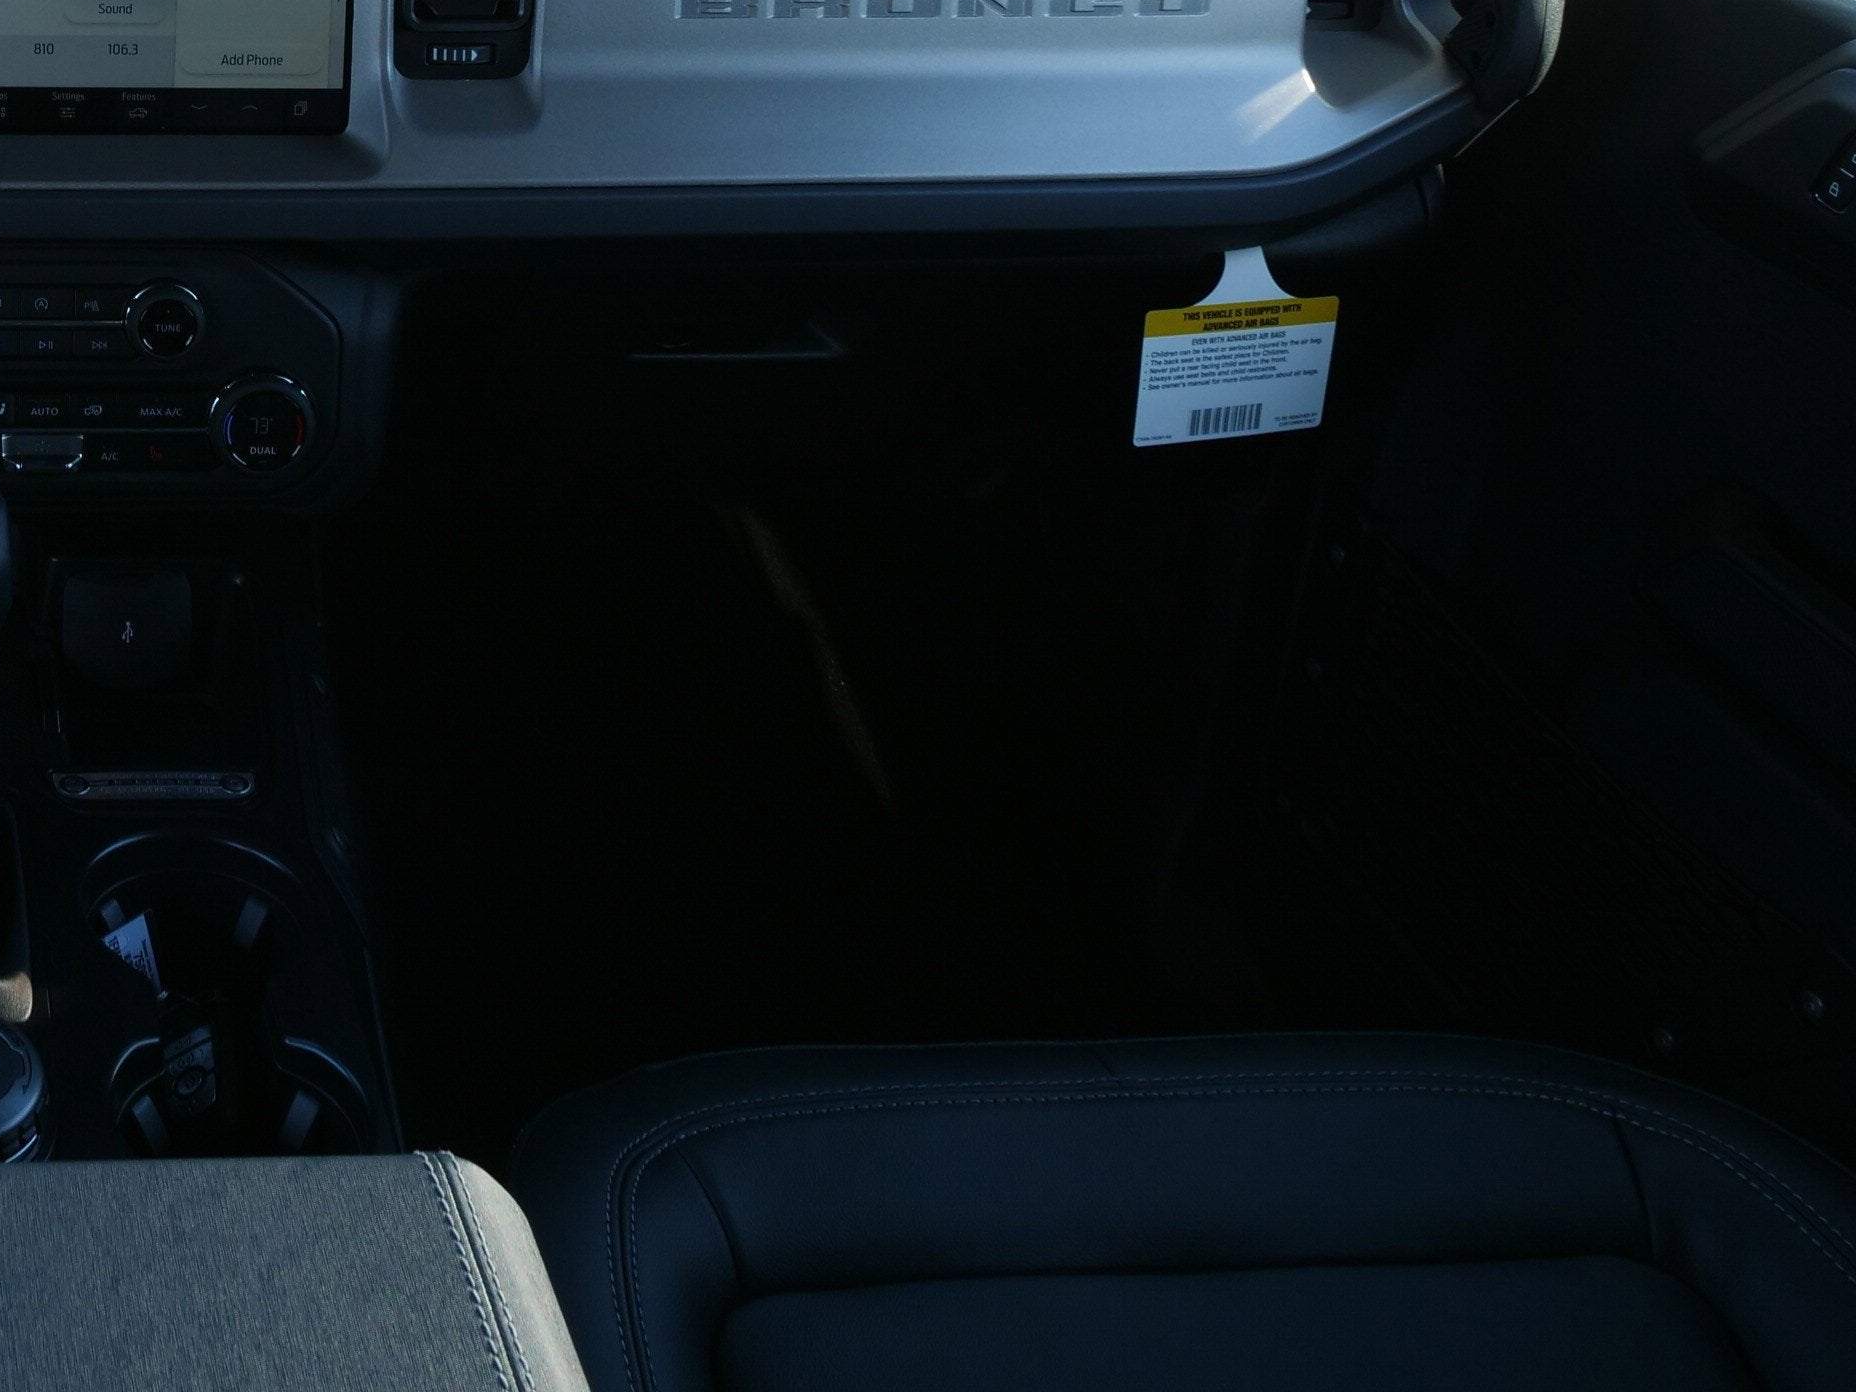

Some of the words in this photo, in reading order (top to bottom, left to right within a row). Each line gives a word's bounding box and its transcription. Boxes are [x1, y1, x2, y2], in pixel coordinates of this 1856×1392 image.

[98, 3, 133, 15] Sound
[34, 43, 54, 55] 810
[107, 43, 139, 56] 106.3
[221, 54, 243, 67] Add
[245, 54, 283, 67] Phone
[52, 92, 85, 102] Settings
[121, 92, 156, 101] Features
[1183, 312, 1200, 321] THIS
[1202, 310, 1233, 319] VEHICLE
[1245, 306, 1280, 316] EQUIPPED
[1283, 304, 1302, 312] WITH
[155, 324, 181, 333] TUNE
[1203, 320, 1242, 332] ADVANCED
[1245, 319, 1258, 327] AIR
[1260, 318, 1279, 326] BAGS
[31, 407, 58, 416] AUTO
[140, 408, 162, 416] MAX
[164, 407, 183, 417] A/C
[249, 446, 277, 455] DUAL
[101, 452, 119, 462] A/C
